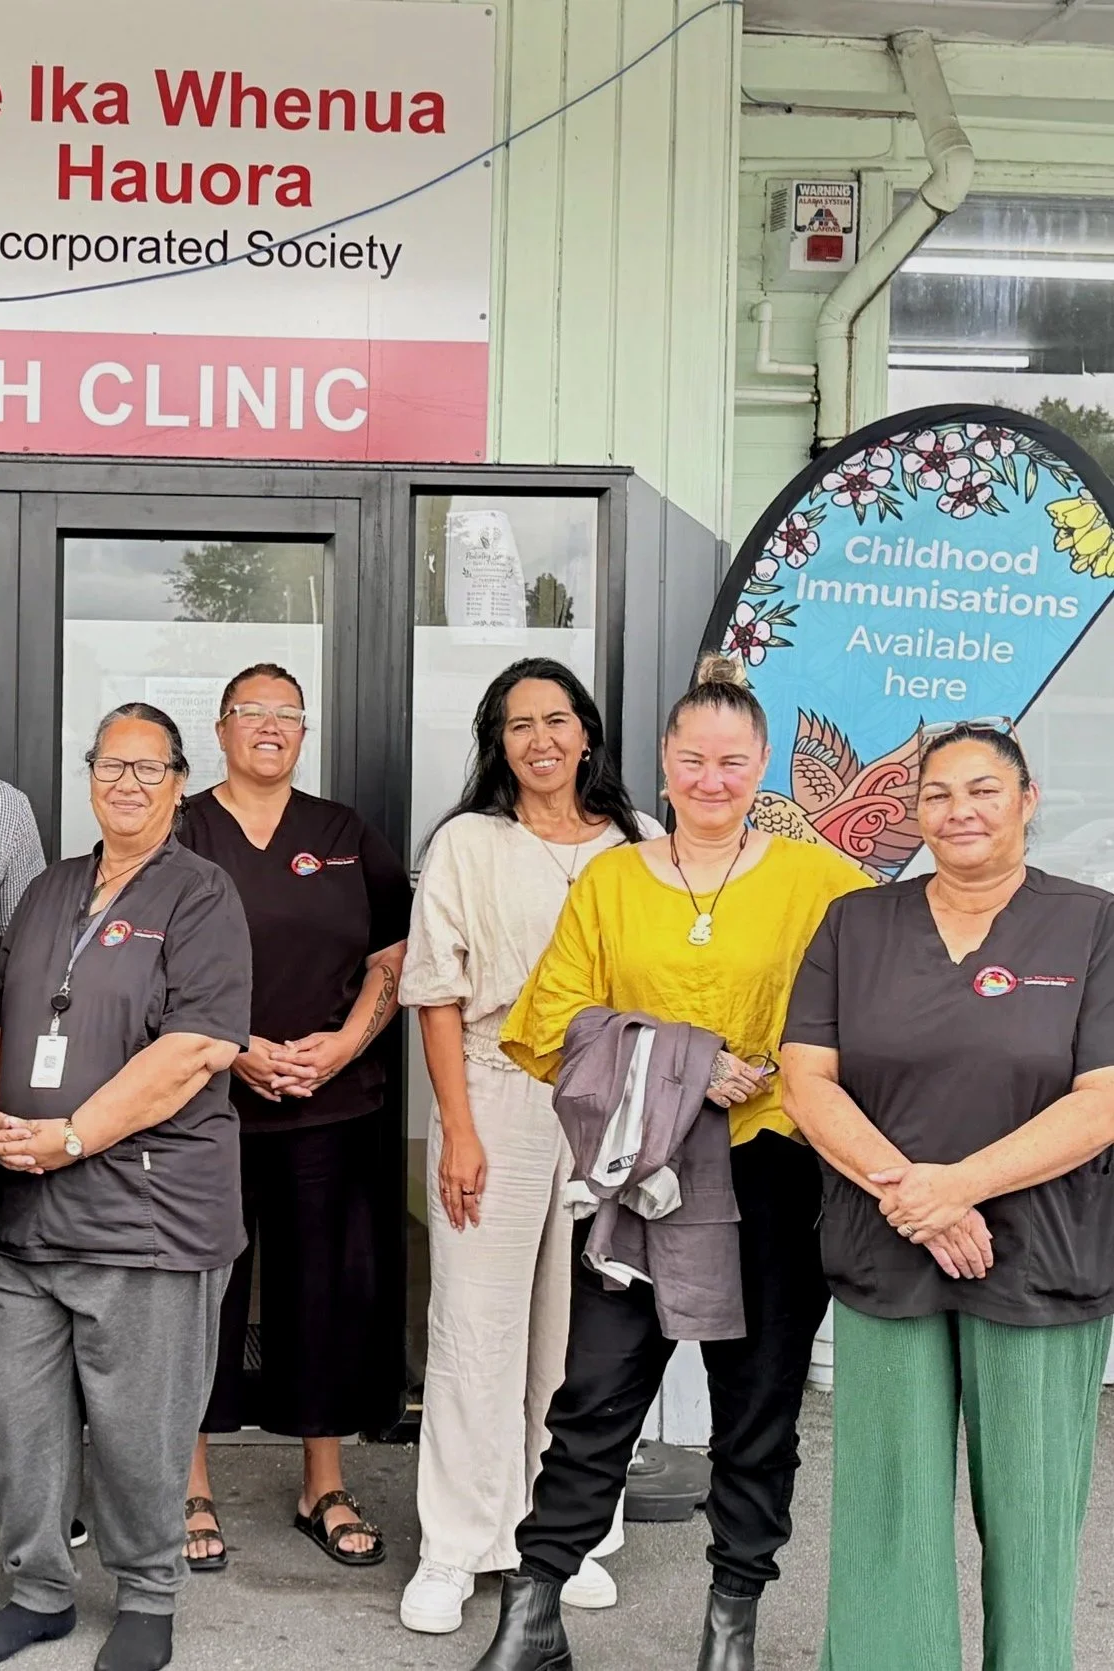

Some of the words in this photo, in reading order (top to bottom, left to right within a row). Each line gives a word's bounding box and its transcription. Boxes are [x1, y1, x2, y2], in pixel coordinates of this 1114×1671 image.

[30, 65, 130, 126] Ika
[154, 68, 446, 134] Whenua
[57, 143, 313, 208] Hauora
[799, 185, 851, 196] WARNING
[798, 198, 824, 206] ALARM
[824, 198, 850, 206] SYSTEM
[246, 230, 402, 279] Society
[78, 361, 369, 432] CLINIC
[844, 535, 1039, 575] Childhood
[795, 573, 1079, 619] Immunisations
[846, 624, 1014, 665] Available
[884, 664, 968, 702] here
